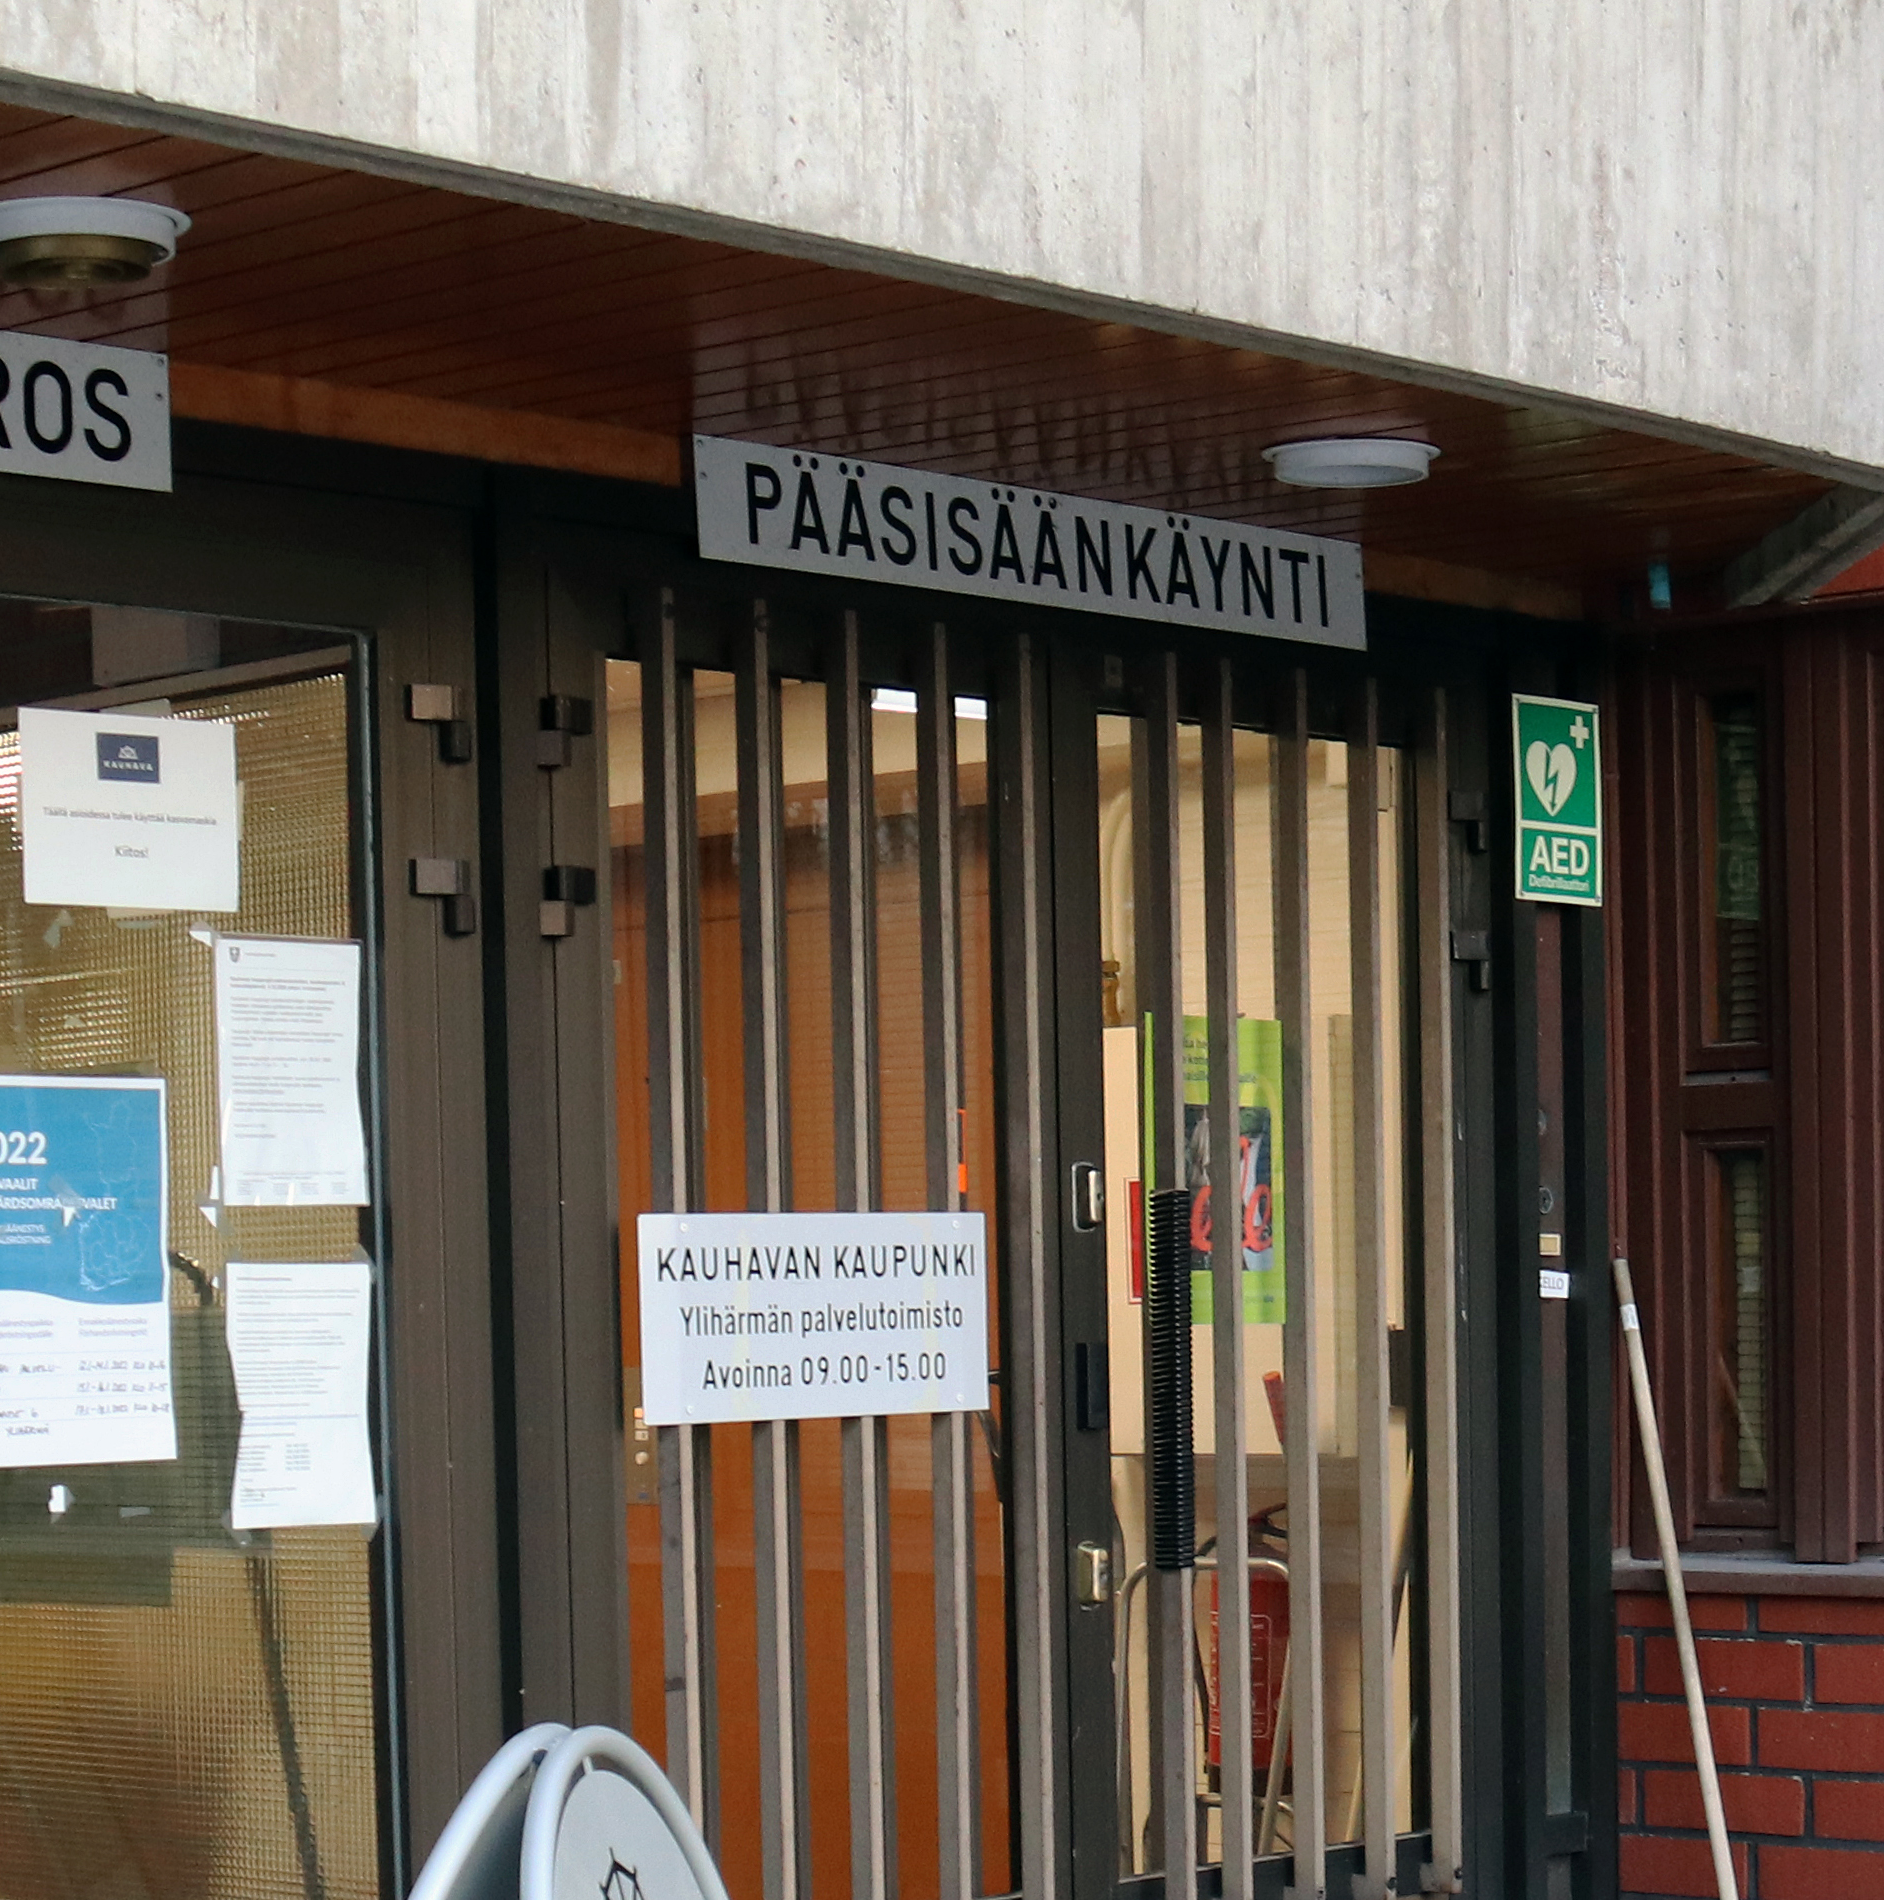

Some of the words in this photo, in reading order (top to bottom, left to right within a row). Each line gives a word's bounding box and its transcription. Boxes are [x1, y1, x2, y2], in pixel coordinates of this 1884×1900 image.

[745, 454, 1329, 628] PÄÄSISÄÄNKÄYNTI
[103, 760, 154, 771] KAUHAVA
[1529, 835, 1590, 876] AED
[657, 1246, 821, 1281] KAUHAVAN
[833, 1244, 976, 1280] KAUPUNKI
[680, 1304, 793, 1337] Ylihärmän
[801, 1300, 963, 1338] palvelutoimisto
[702, 1358, 792, 1389] Avoinna
